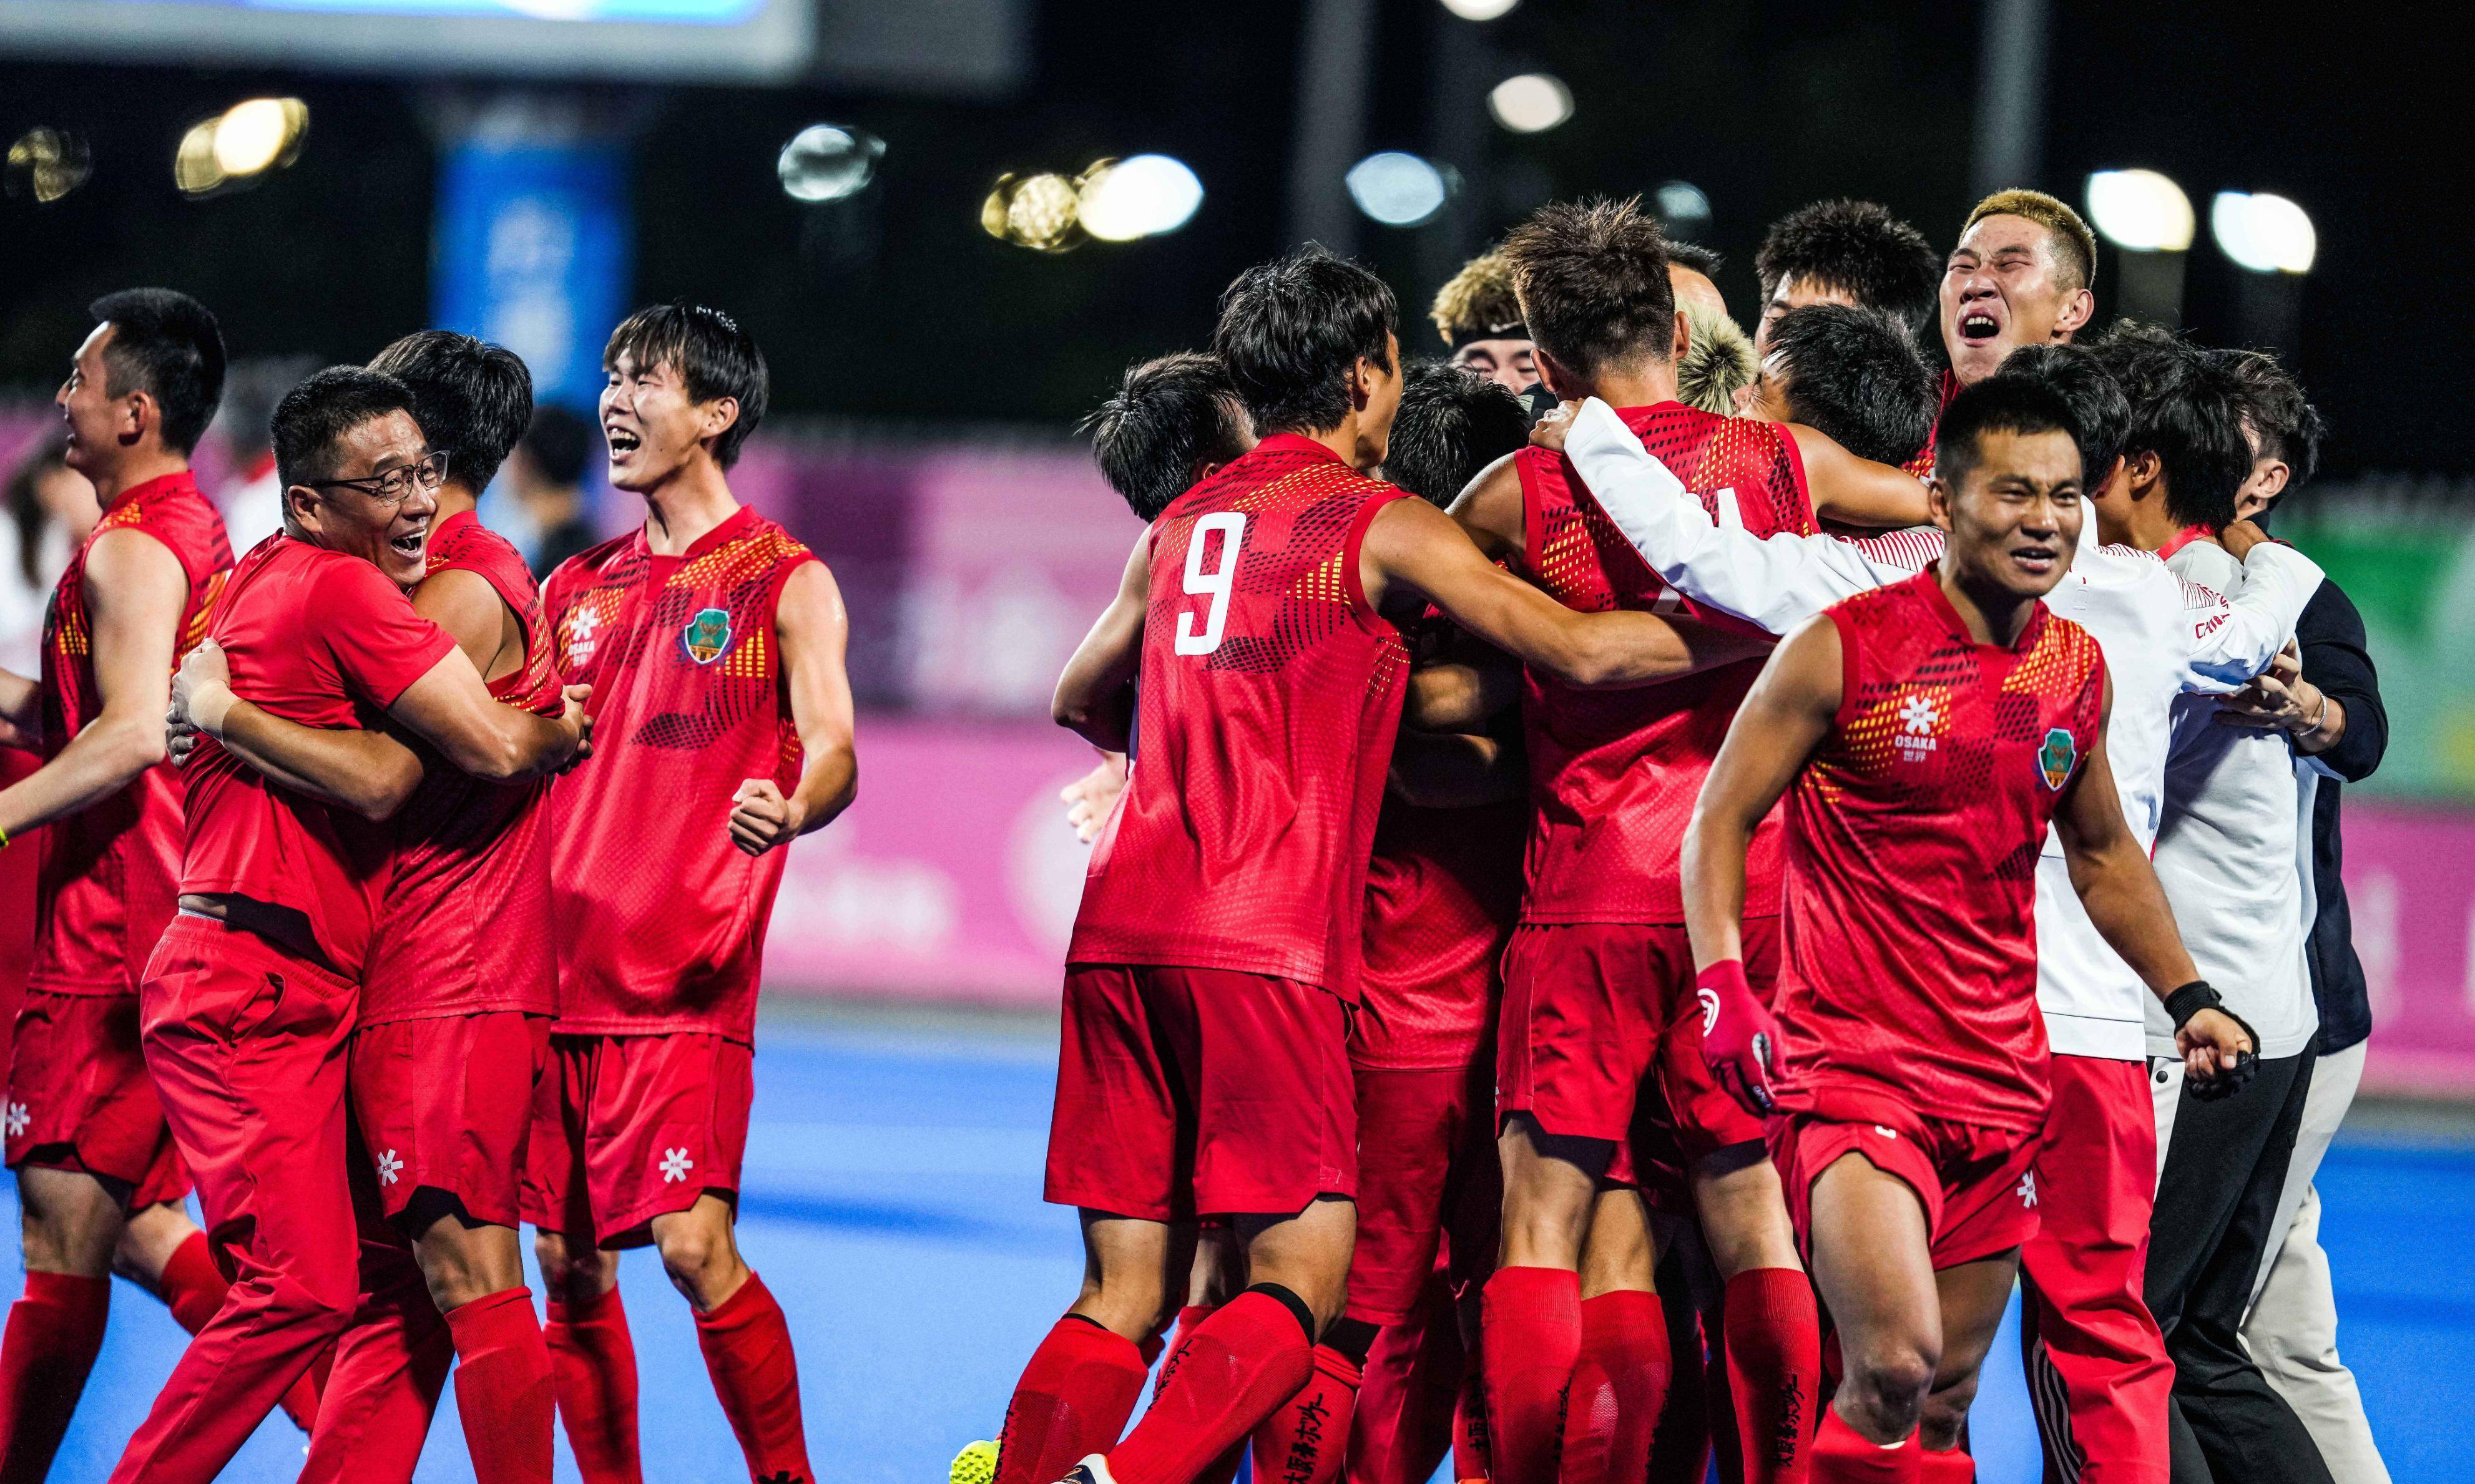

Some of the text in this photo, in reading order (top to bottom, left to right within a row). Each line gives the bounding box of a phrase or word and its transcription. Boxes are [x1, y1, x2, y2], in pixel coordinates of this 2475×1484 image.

[1174, 511, 1247, 657] 9
[568, 640, 595, 657] OSAKA
[1895, 735, 1937, 751] OSAKA
